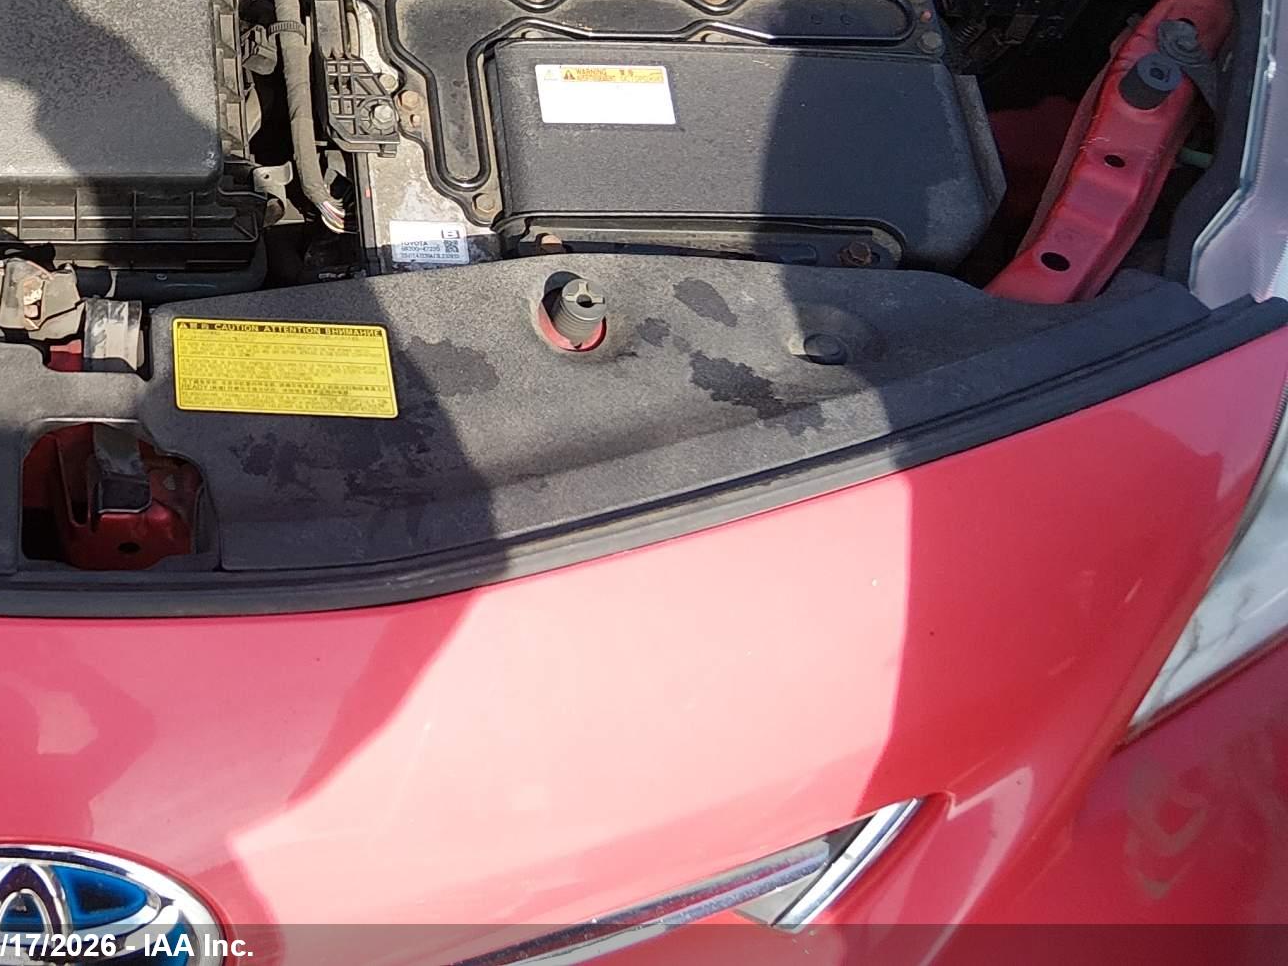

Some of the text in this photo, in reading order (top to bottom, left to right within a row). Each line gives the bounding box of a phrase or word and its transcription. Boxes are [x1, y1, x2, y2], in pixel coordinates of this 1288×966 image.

[214, 322, 259, 332] CAUTION
[263, 325, 321, 334] ATTENTION
[324, 327, 383, 337] ВНИМАНИЕ
